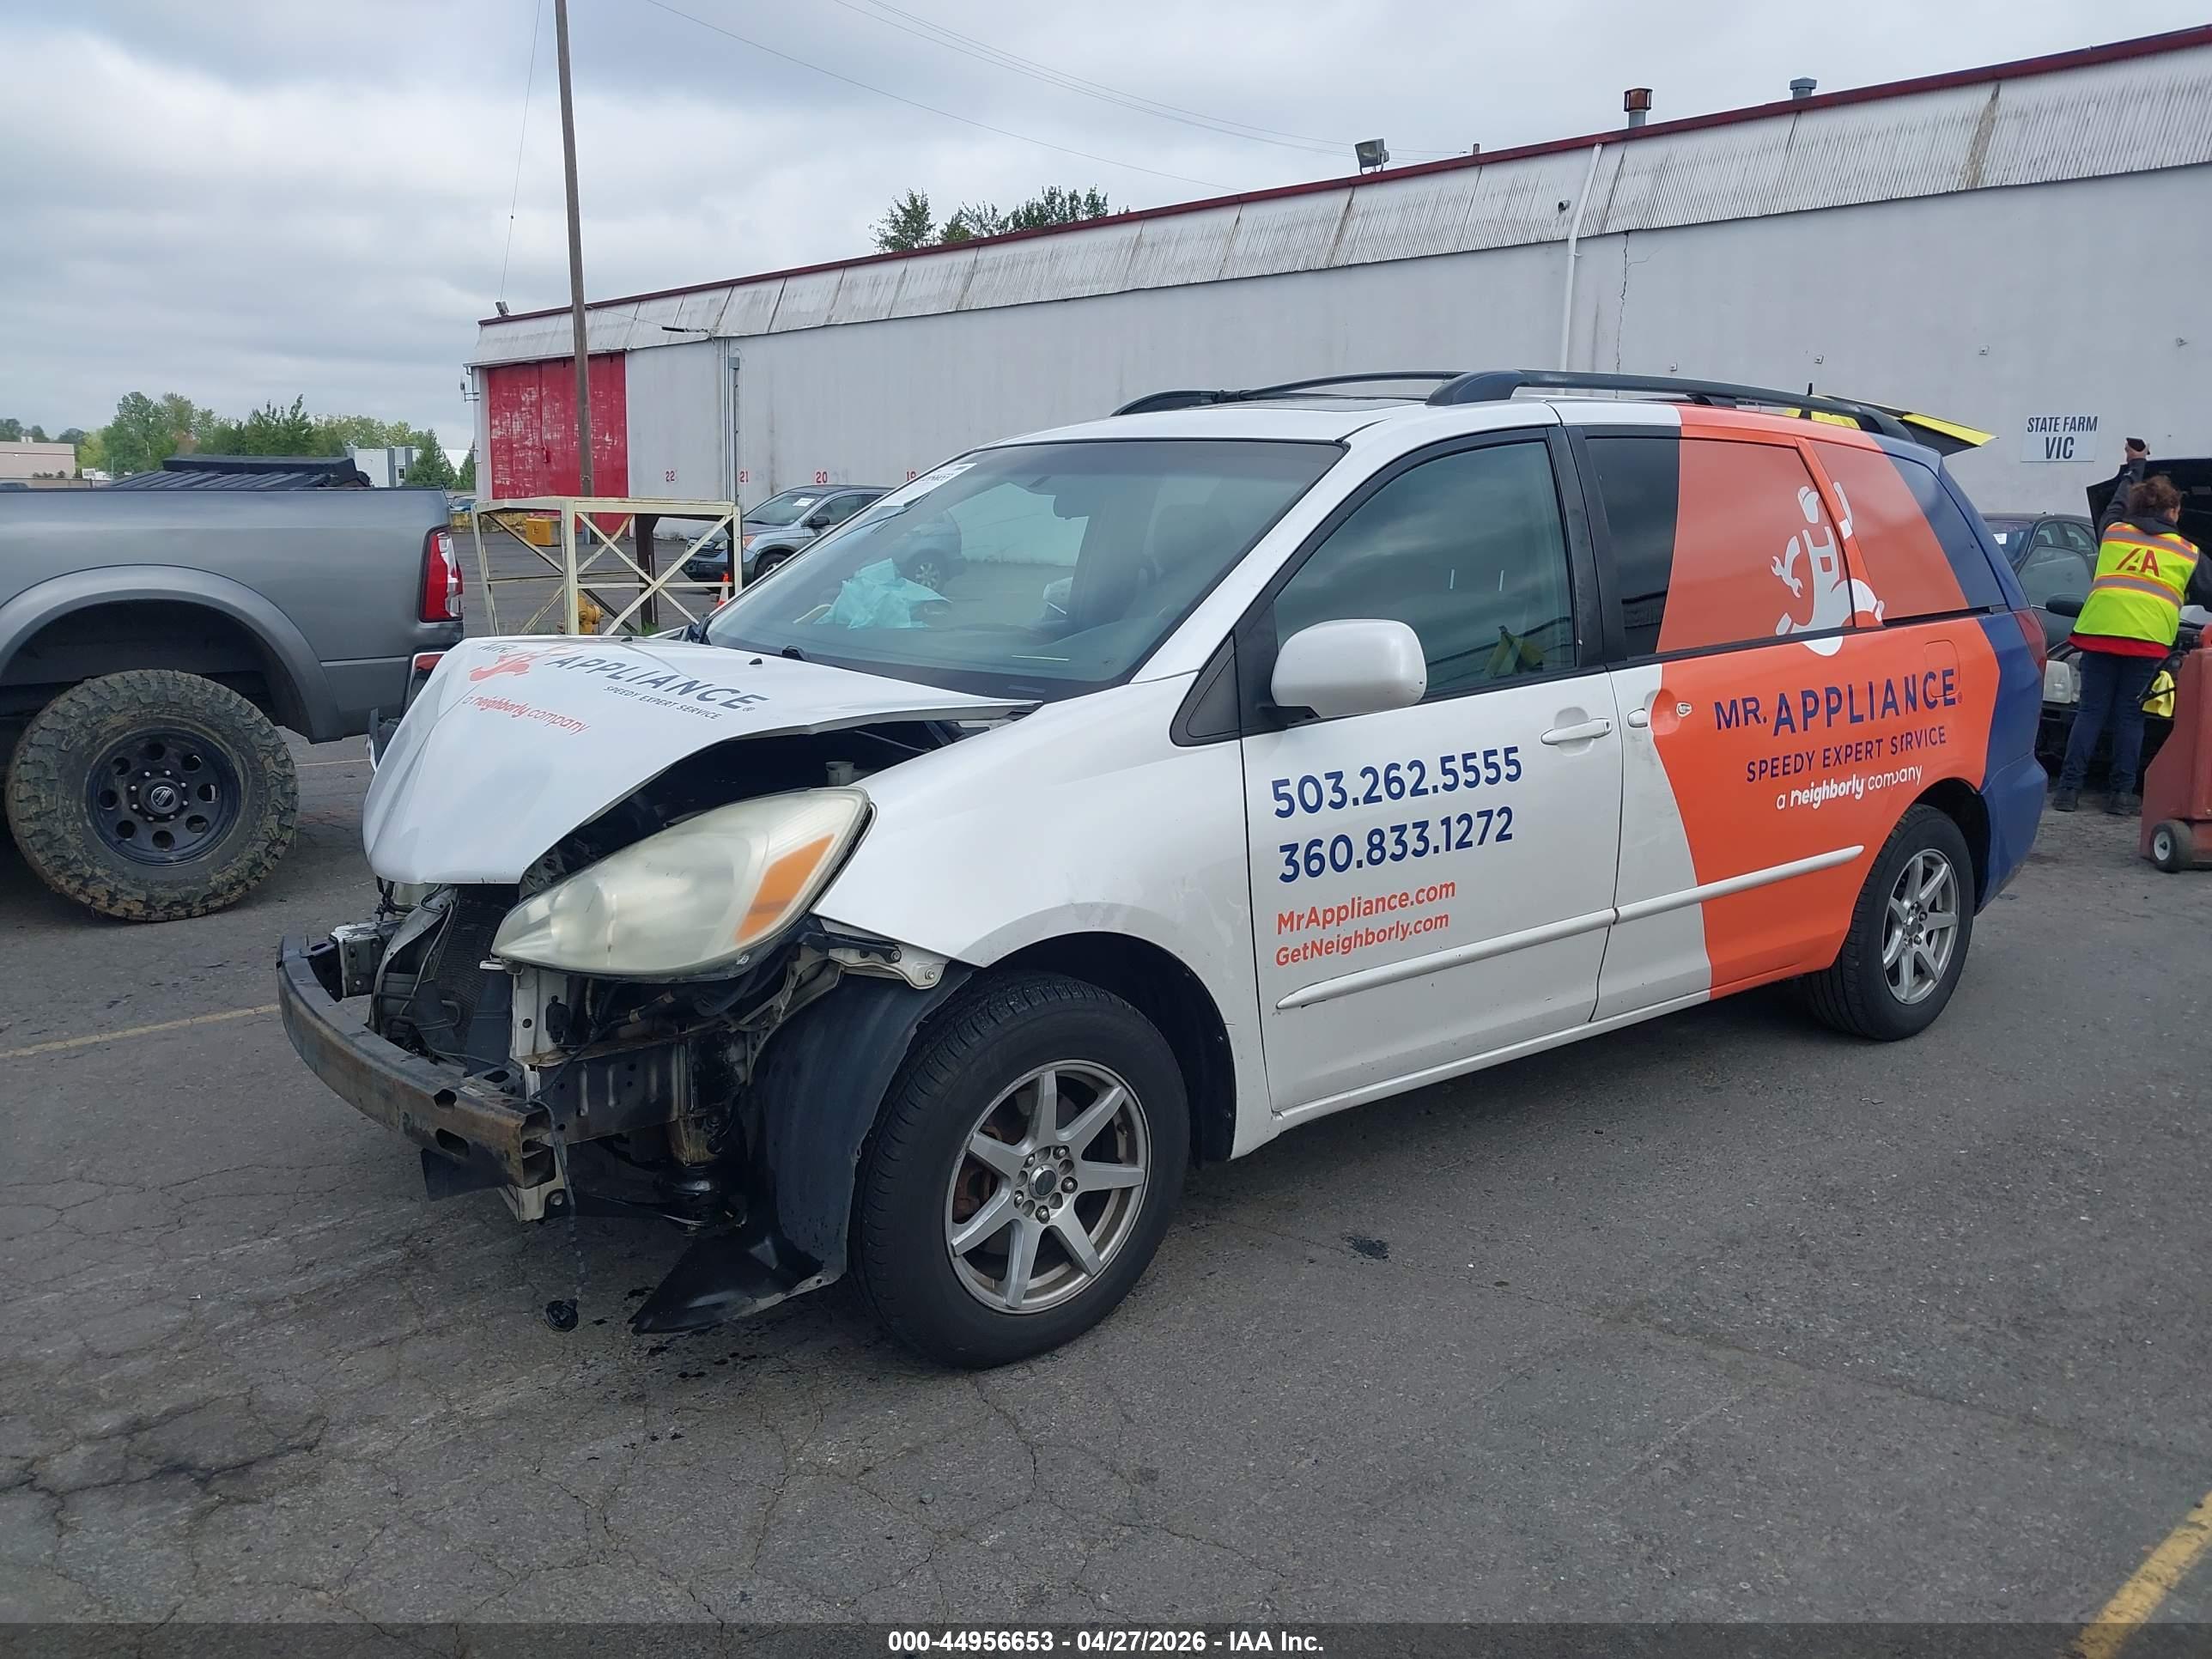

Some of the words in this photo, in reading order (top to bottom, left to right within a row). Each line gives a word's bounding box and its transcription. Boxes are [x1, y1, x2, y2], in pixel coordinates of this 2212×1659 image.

[2027, 416, 2061, 432] STATE
[2063, 416, 2099, 432] FARM
[2045, 436, 2075, 459] VIC
[665, 471, 675, 482] 22
[739, 471, 749, 483] 21
[816, 471, 828, 483] 20
[477, 643, 519, 655] MR.
[472, 696, 531, 718] neighborly
[526, 709, 591, 736] company
[603, 685, 641, 698] SPEEDY
[639, 695, 679, 708] EXPERT
[676, 704, 723, 720] SERVICE
[1714, 696, 1767, 730] MR.
[1747, 750, 1815, 782] SPEEDY
[1822, 738, 1883, 769] EXPERT
[1272, 746, 1522, 818] 503.262.5555
[1777, 793, 1785, 810] a
[1790, 775, 1864, 809] neighborly
[1279, 806, 1513, 883] 360.833.1272
[1277, 881, 1456, 935] MrAppliance.com
[1275, 913, 1449, 966] GetNeighborly.com
